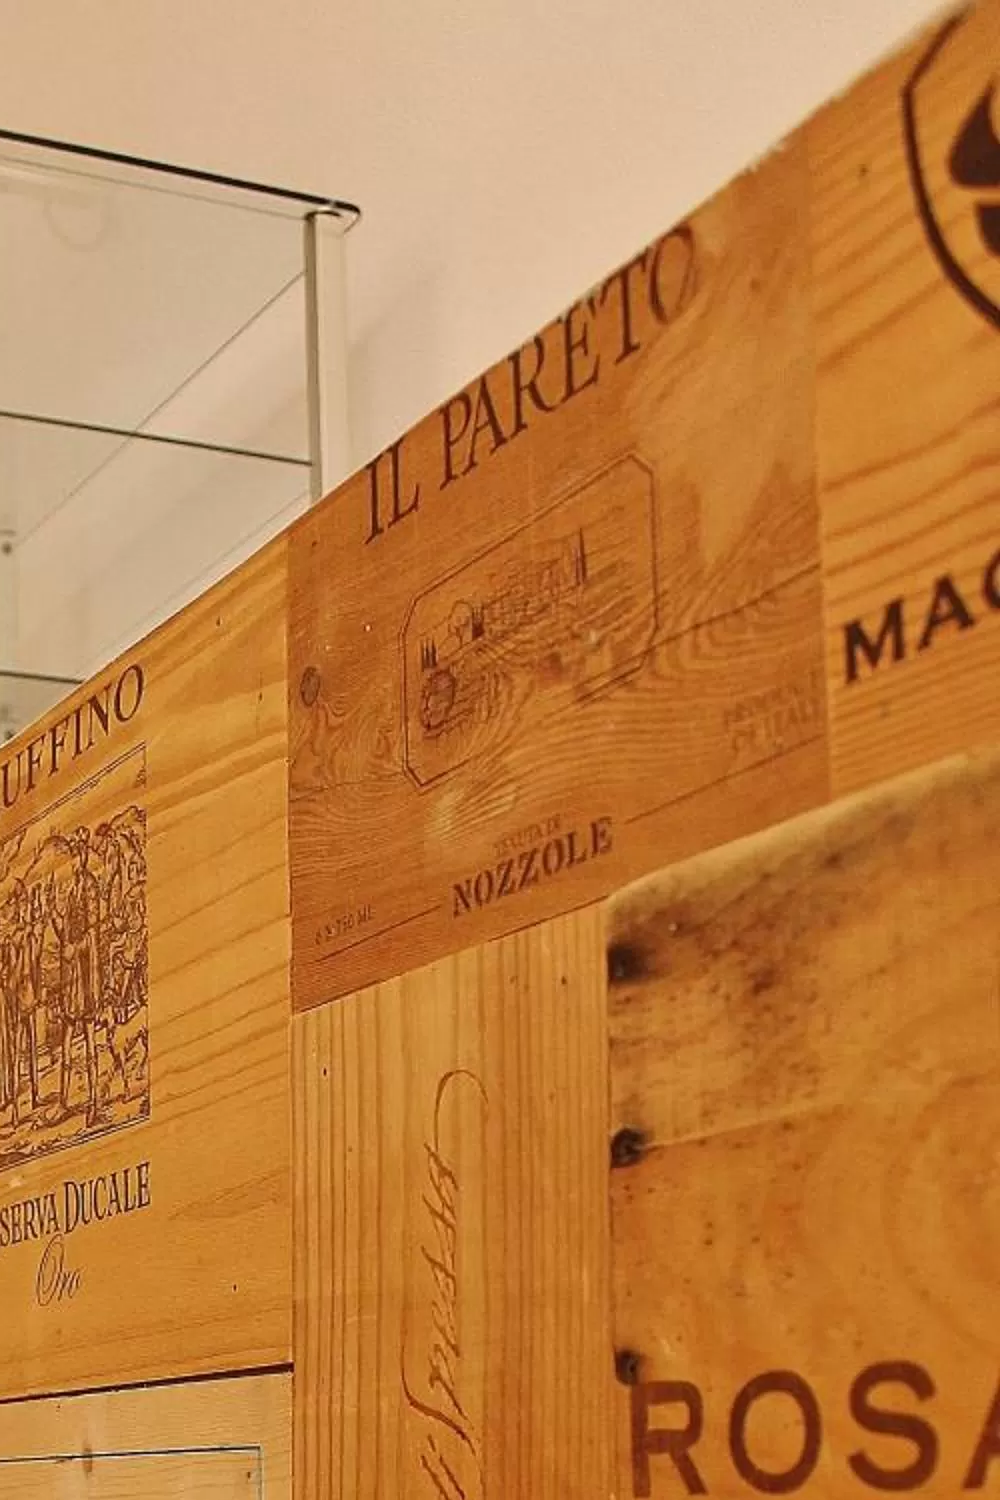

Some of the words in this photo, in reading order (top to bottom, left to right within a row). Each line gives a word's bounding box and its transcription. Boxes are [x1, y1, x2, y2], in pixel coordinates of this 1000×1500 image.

[362, 436, 422, 546] IL
[438, 223, 699, 491] PARETO
[452, 815, 613, 919] NOZZOLE
[63, 1161, 151, 1235] DUCALE
